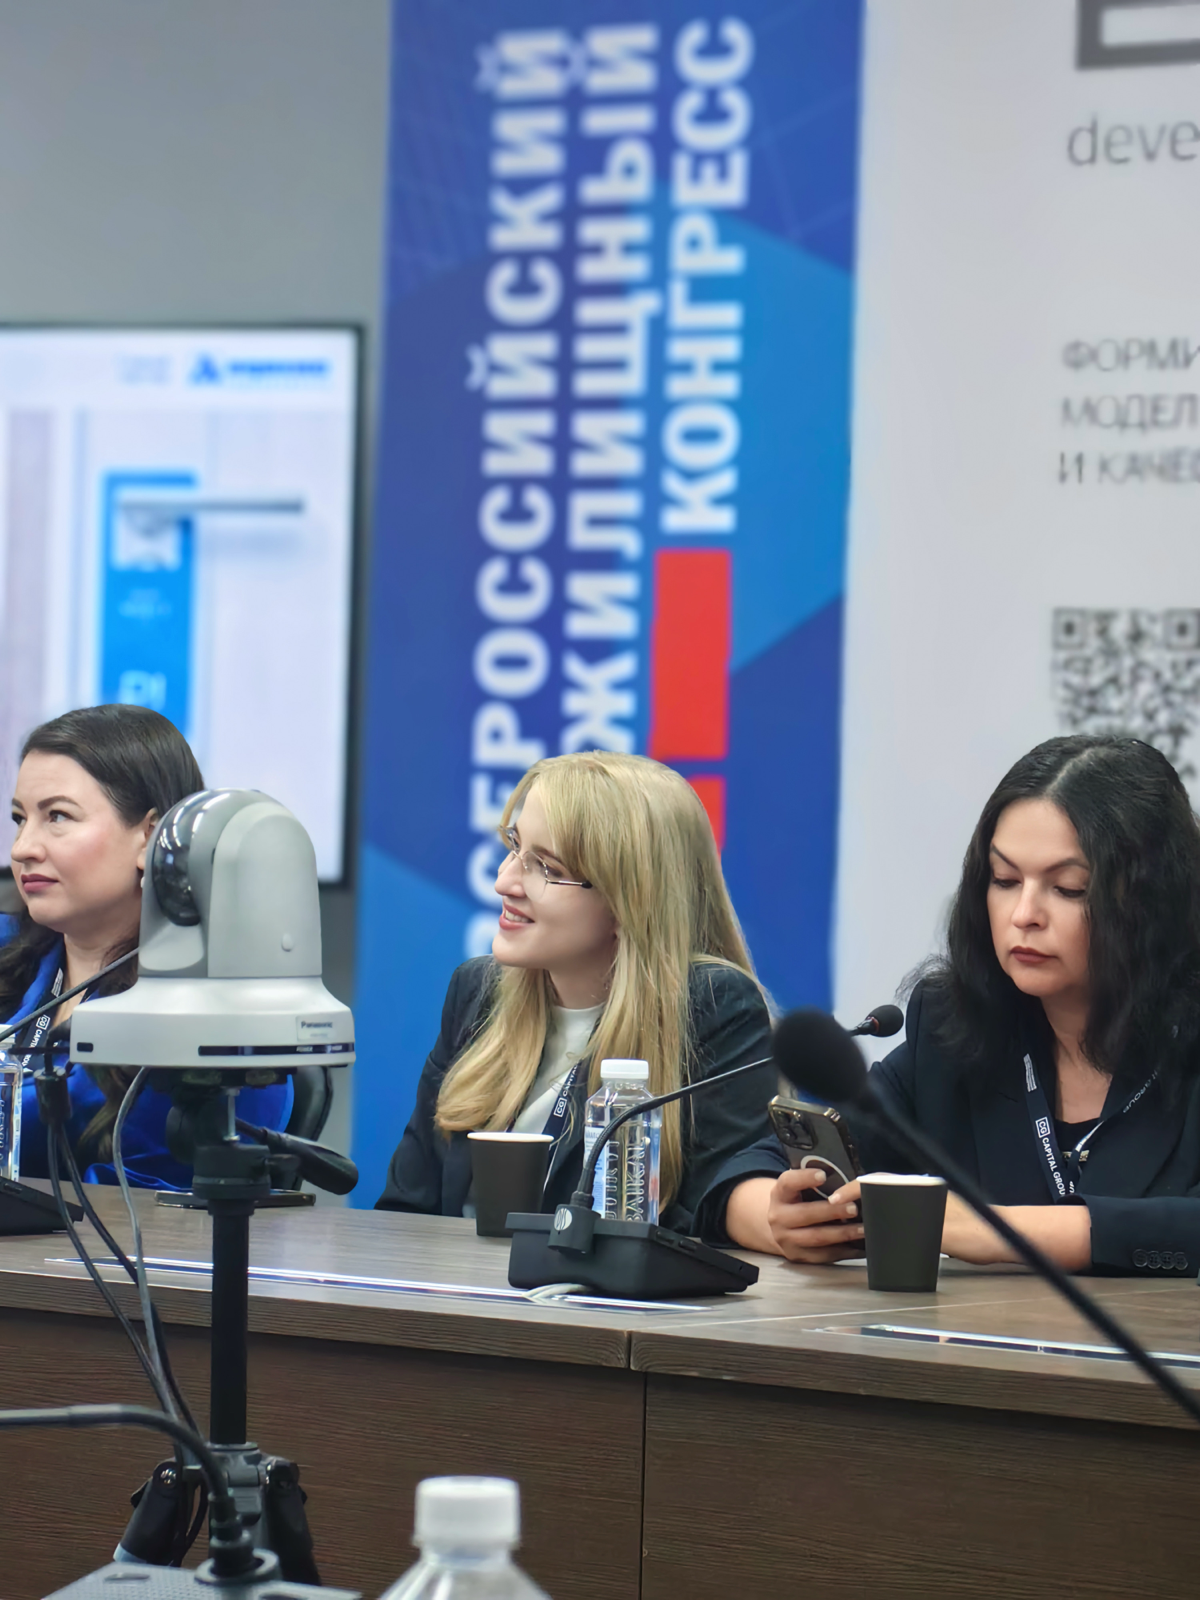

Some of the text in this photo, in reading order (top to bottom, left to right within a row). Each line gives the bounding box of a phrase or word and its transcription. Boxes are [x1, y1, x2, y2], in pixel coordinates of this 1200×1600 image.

[465, 28, 567, 956] ЕРОССИЙСКИЙ
[560, 22, 662, 753] ЖИЛИЩНЫЙ
[660, 17, 755, 534] КОНГРЕСС
[1037, 1118, 1065, 1196] CG CAPITAL GROU
